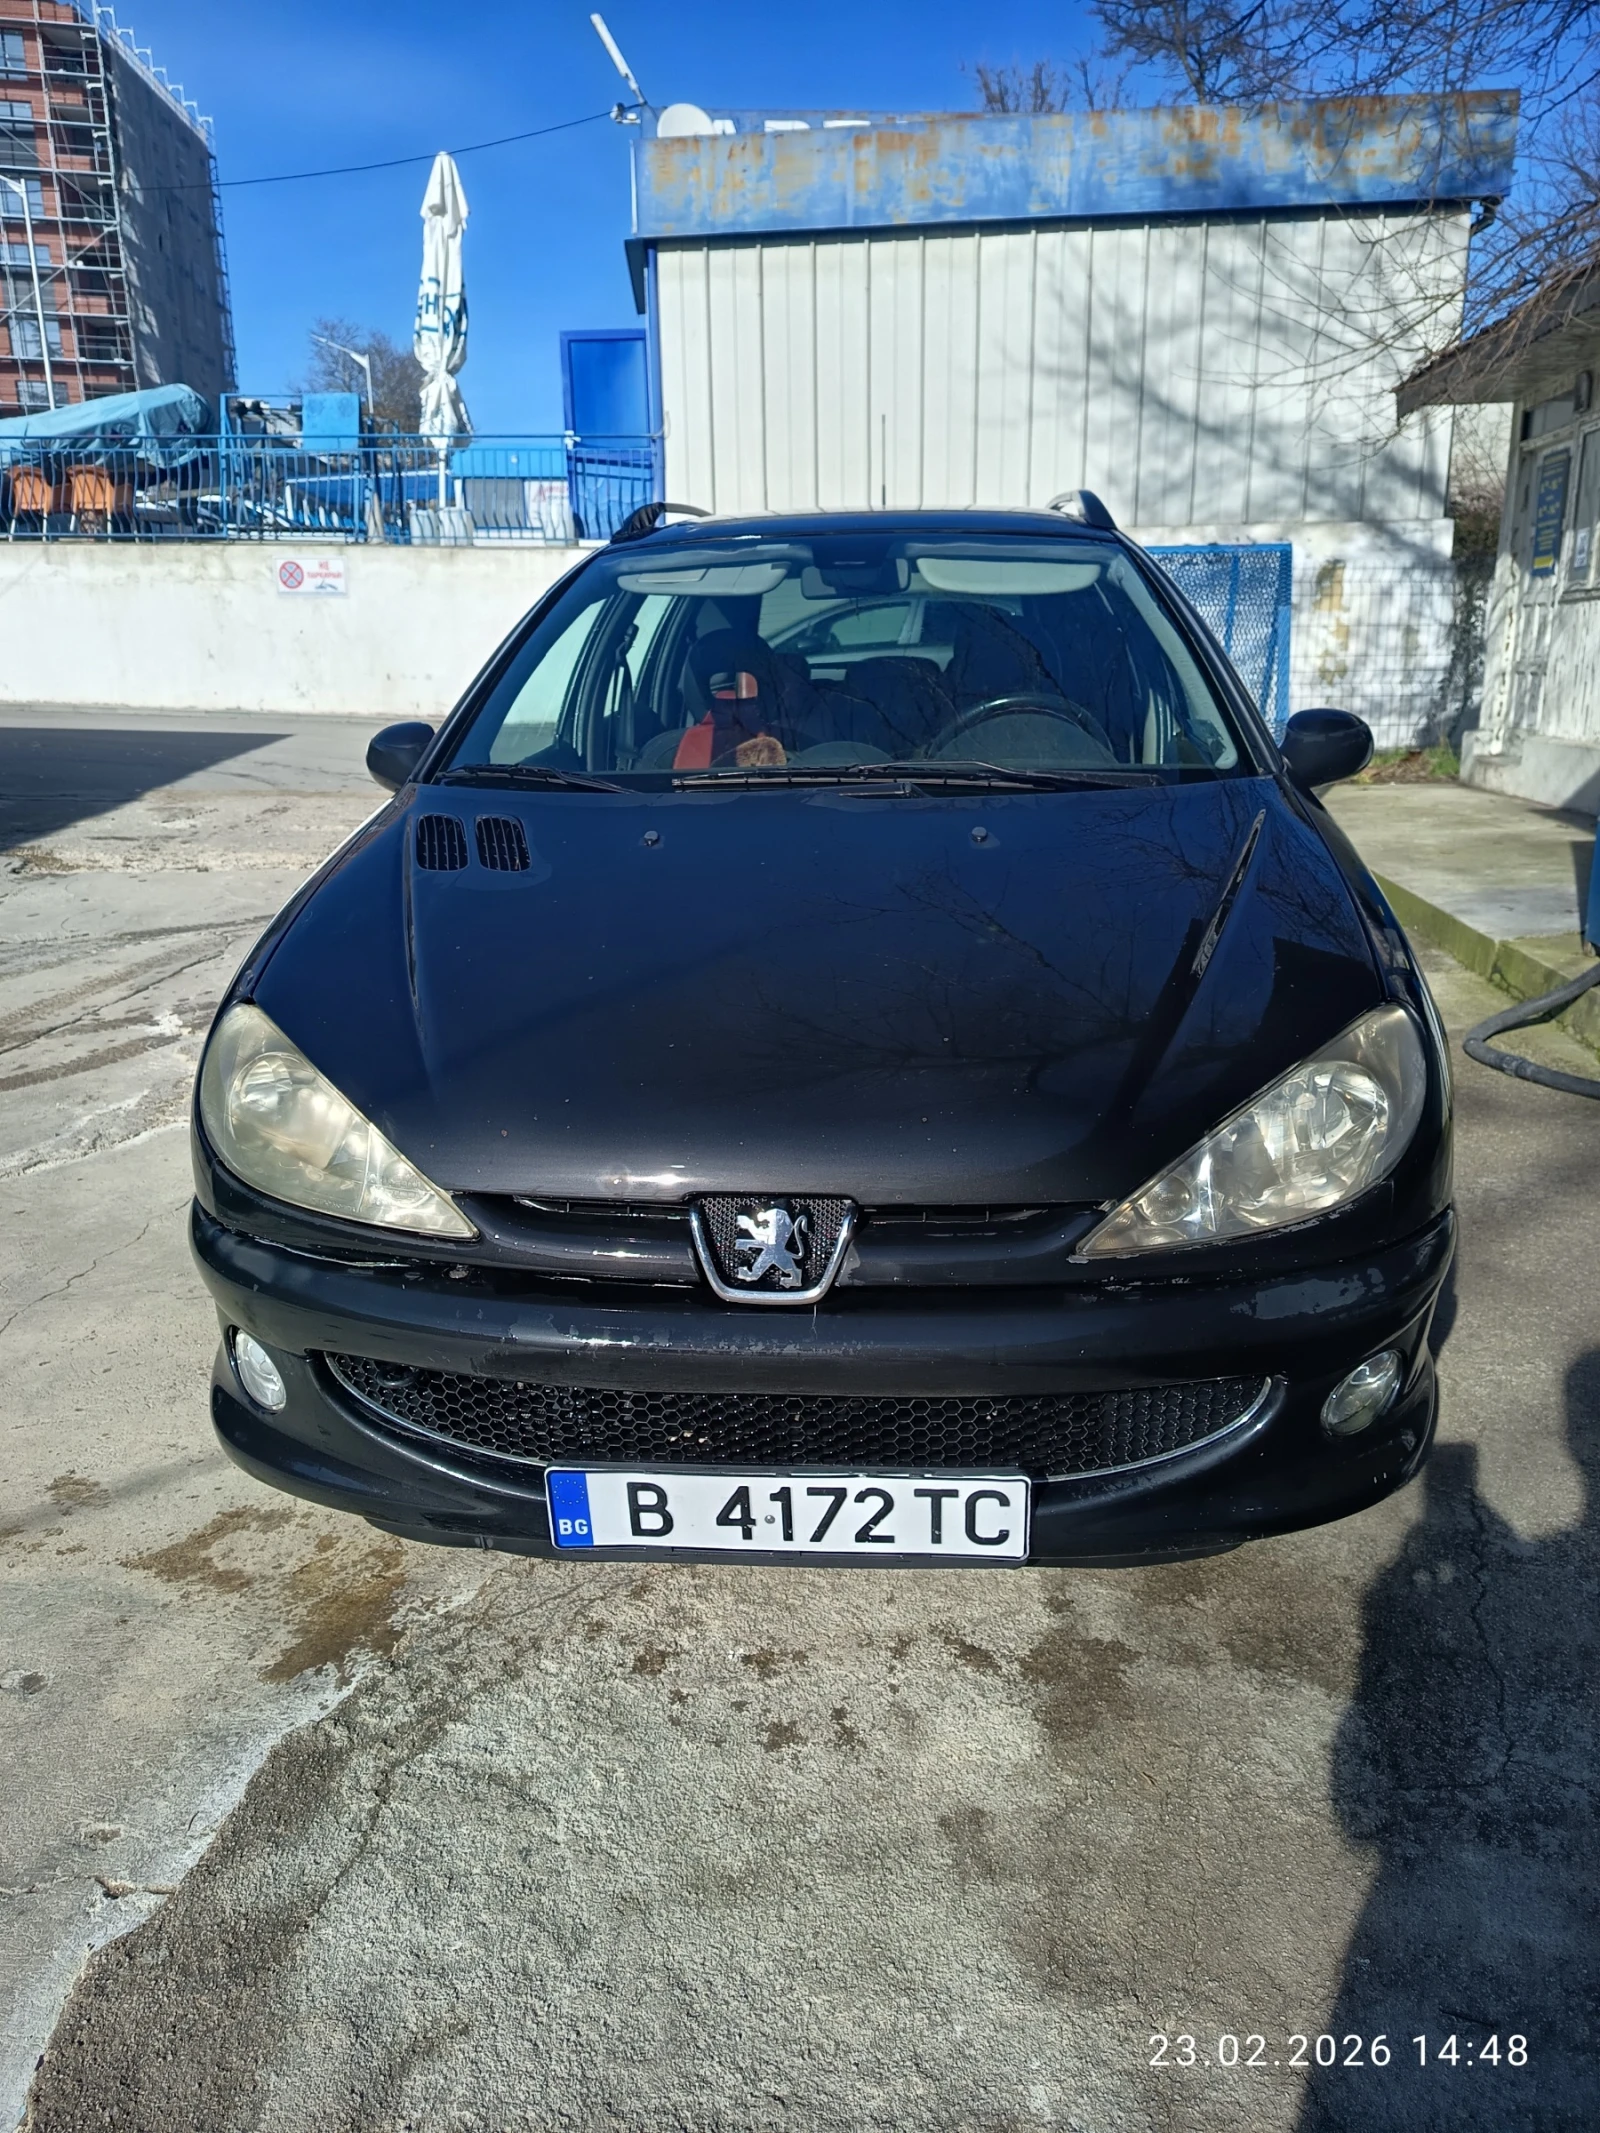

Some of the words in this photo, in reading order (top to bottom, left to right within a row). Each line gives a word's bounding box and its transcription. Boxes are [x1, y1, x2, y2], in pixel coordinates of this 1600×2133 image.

[558, 1518, 589, 1535] BG
[626, 1481, 674, 1538] B
[715, 1485, 896, 1544] 4172
[913, 1488, 1011, 1546] TC
